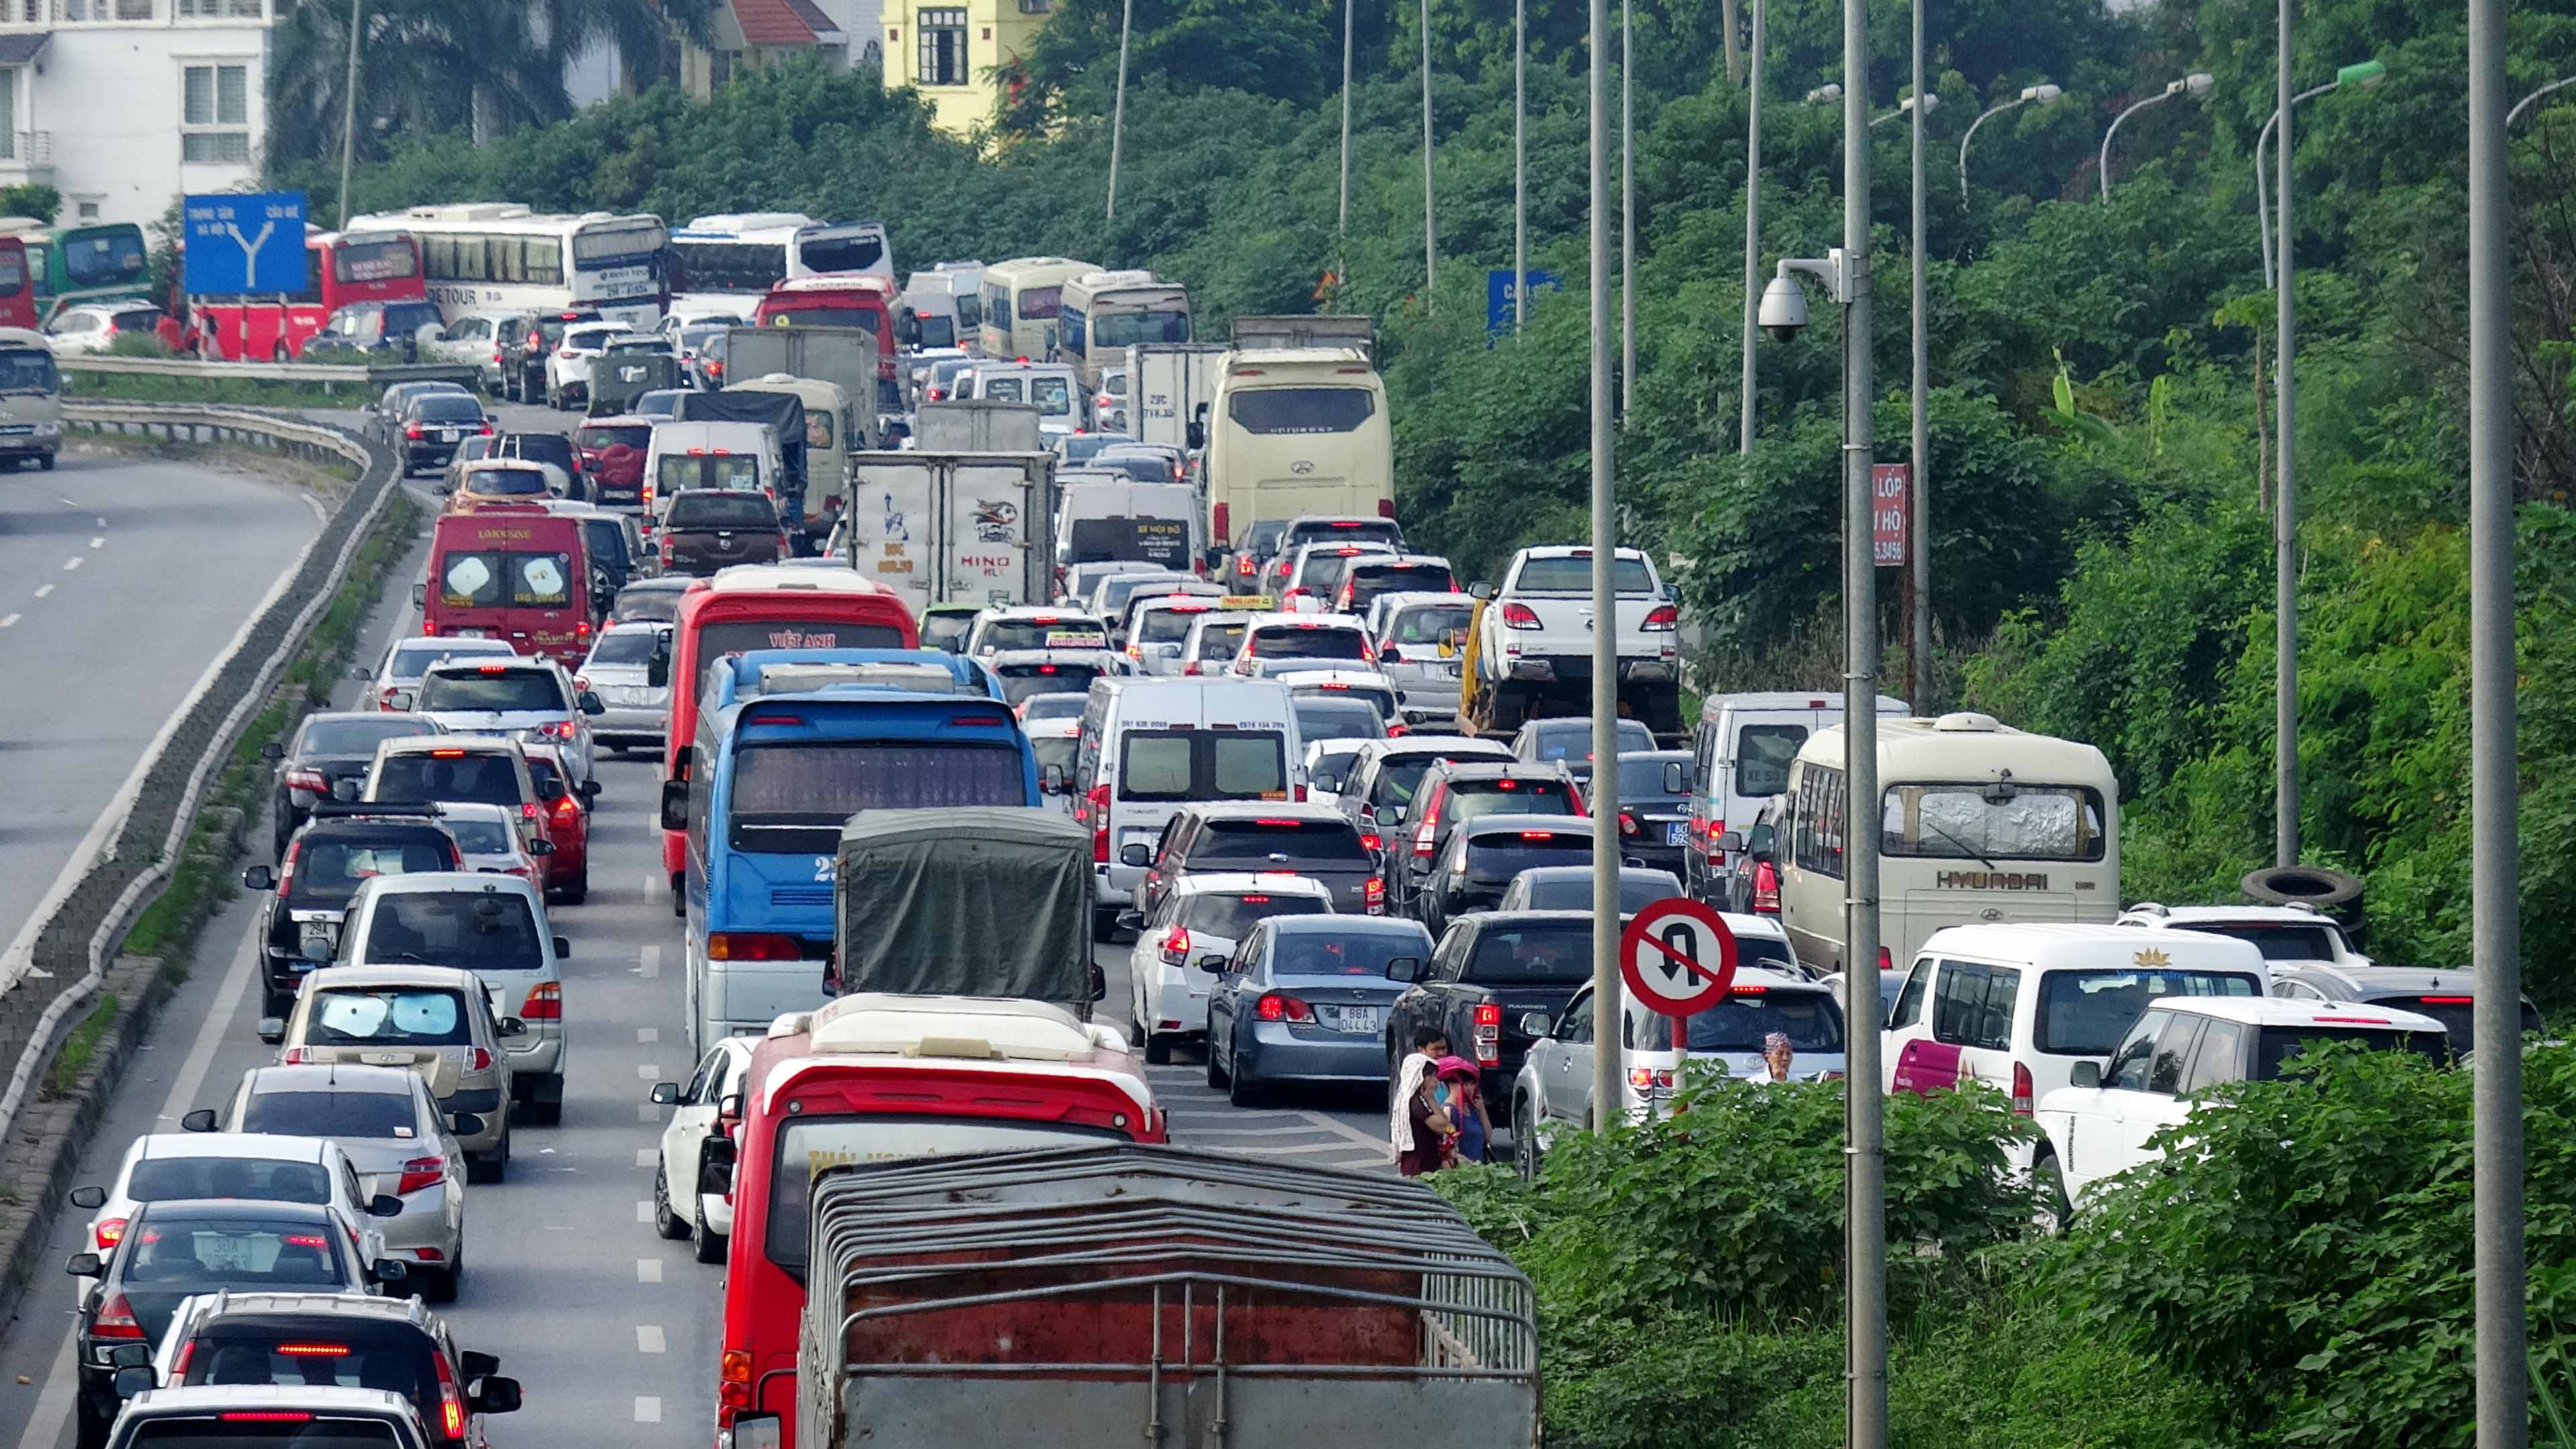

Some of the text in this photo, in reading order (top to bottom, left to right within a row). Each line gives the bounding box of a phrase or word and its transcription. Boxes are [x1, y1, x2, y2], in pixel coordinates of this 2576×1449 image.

[445, 290, 476, 305] TOUR
[1878, 468, 1902, 497] LỐP
[1882, 504, 1901, 537] HỘ
[961, 556, 1010, 566] HINO
[769, 630, 837, 649] VIỆT ANH
[1937, 871, 2048, 891] HYUNDAI
